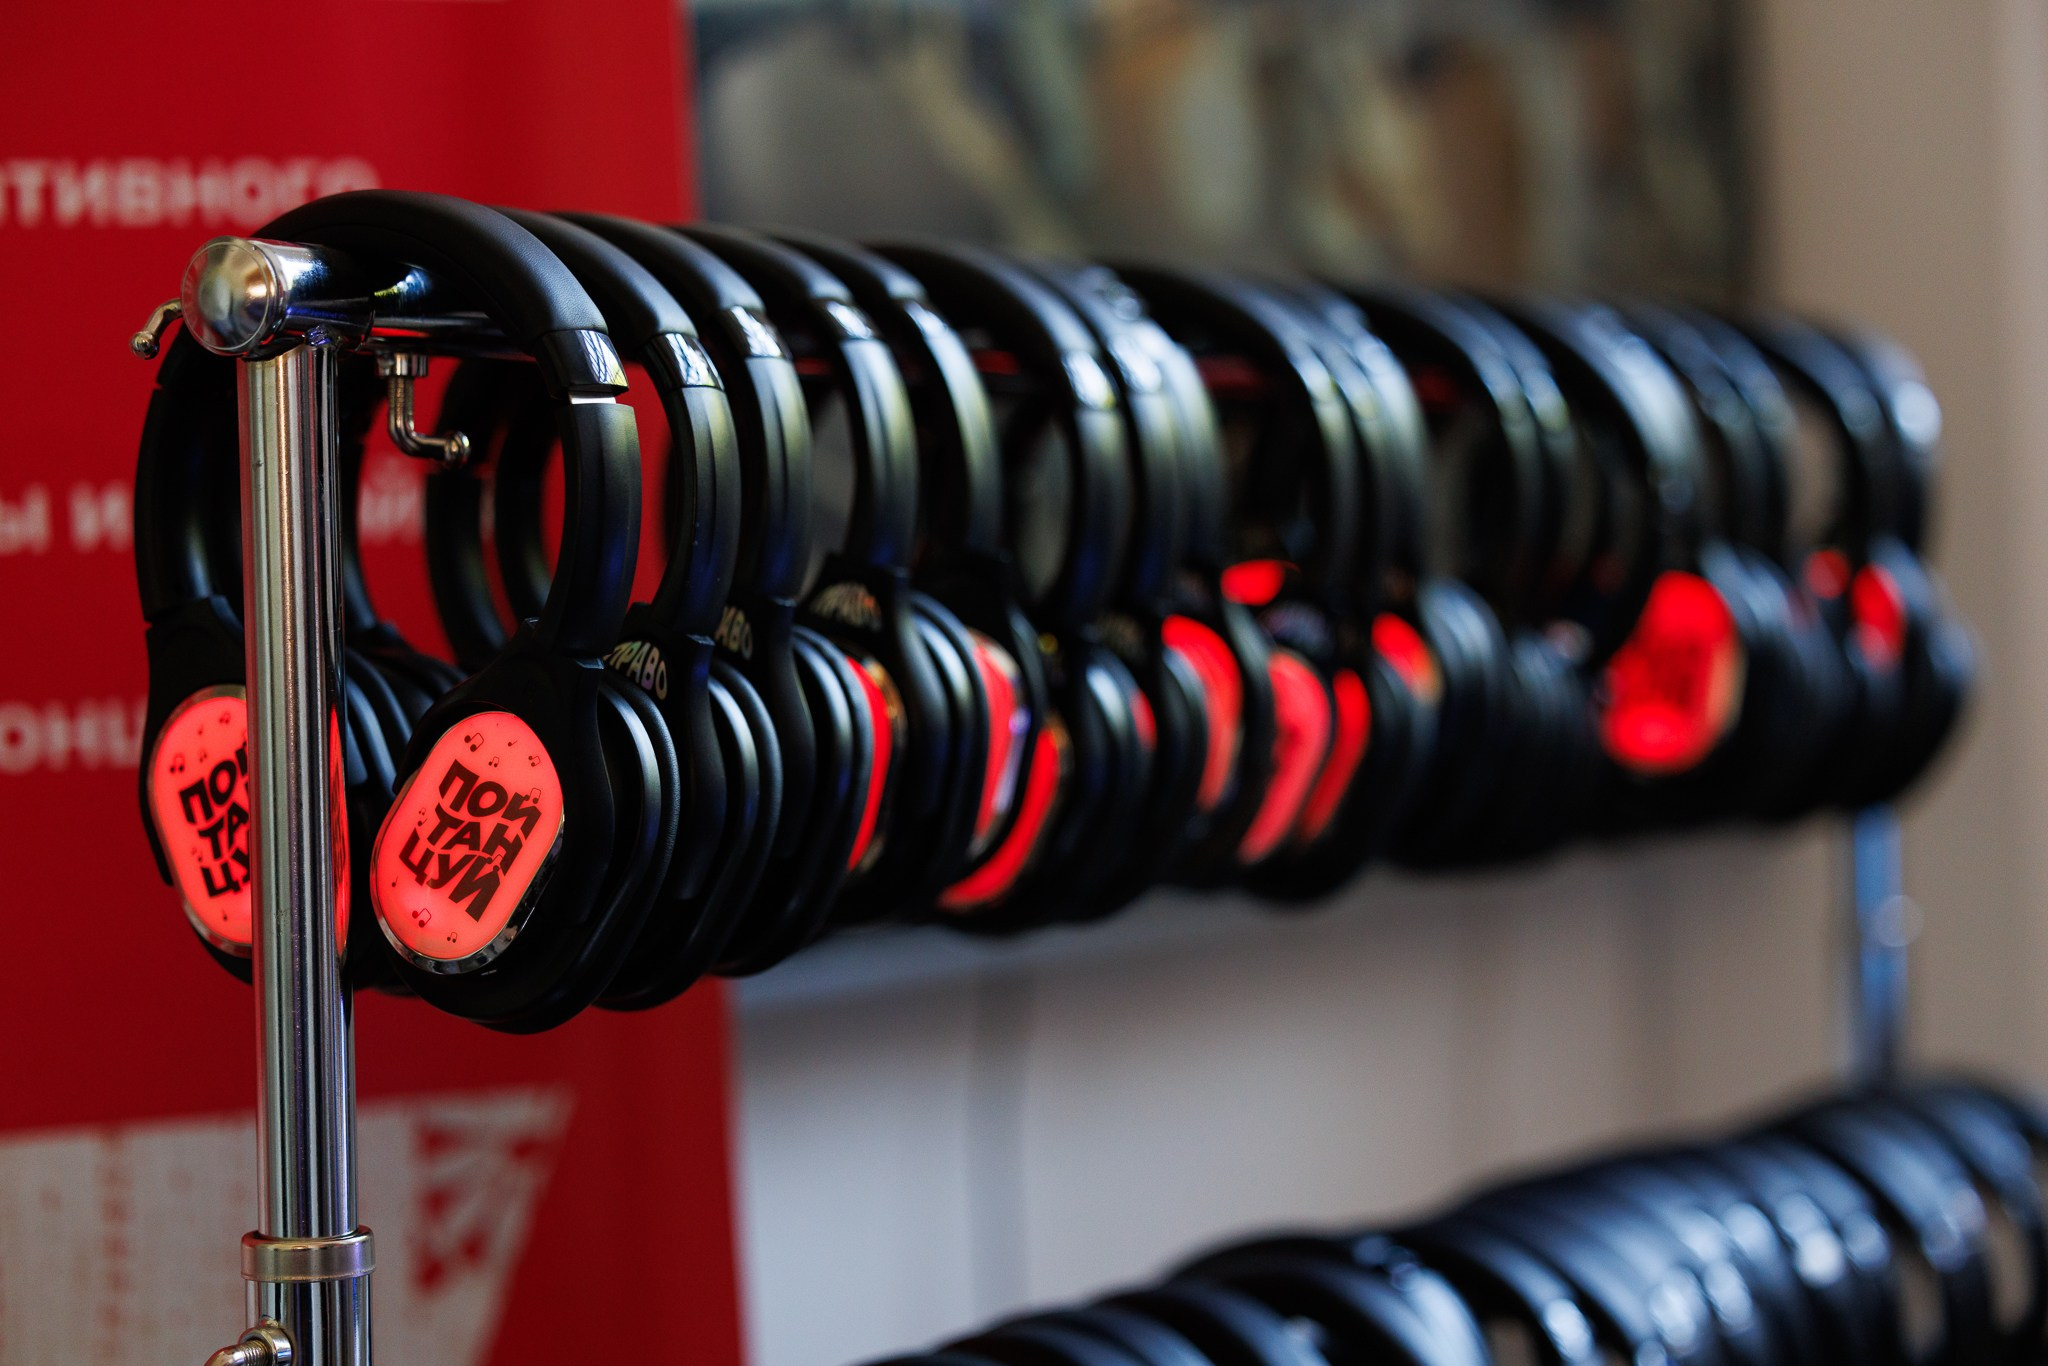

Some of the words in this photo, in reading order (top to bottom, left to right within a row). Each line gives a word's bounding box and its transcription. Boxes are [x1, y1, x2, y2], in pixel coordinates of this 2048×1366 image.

[0, 155, 380, 229] ТИВНОГ
[714, 605, 753, 660] АВО
[602, 640, 668, 700] ПРАВО
[197, 801, 250, 861] ТА
[438, 758, 542, 841] ПОЙ
[200, 847, 251, 898] ЦУ
[426, 802, 523, 877] ТАН
[398, 827, 501, 923] ЦУЙ
